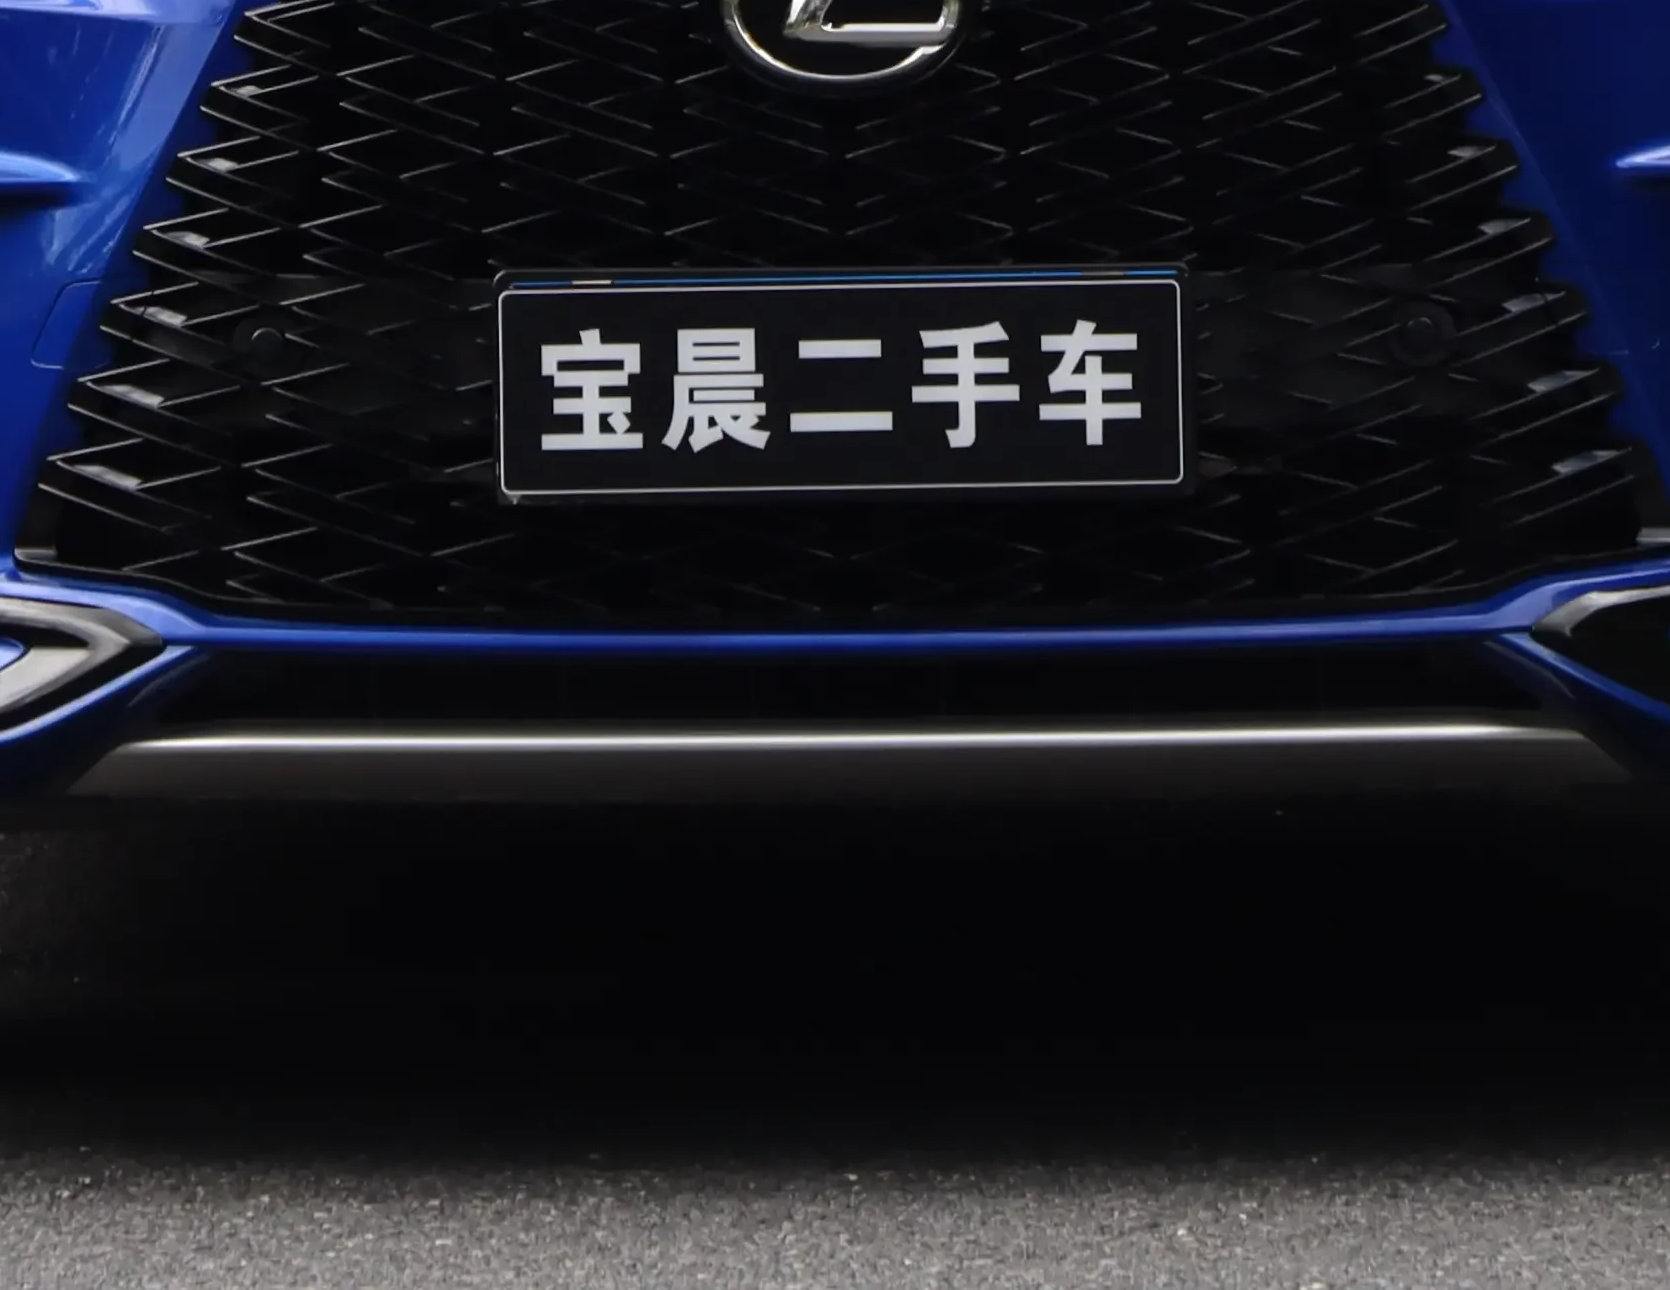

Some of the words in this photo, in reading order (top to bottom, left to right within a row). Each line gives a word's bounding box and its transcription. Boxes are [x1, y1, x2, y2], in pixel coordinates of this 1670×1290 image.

[541, 319, 1142, 453] 宝晨二手车
